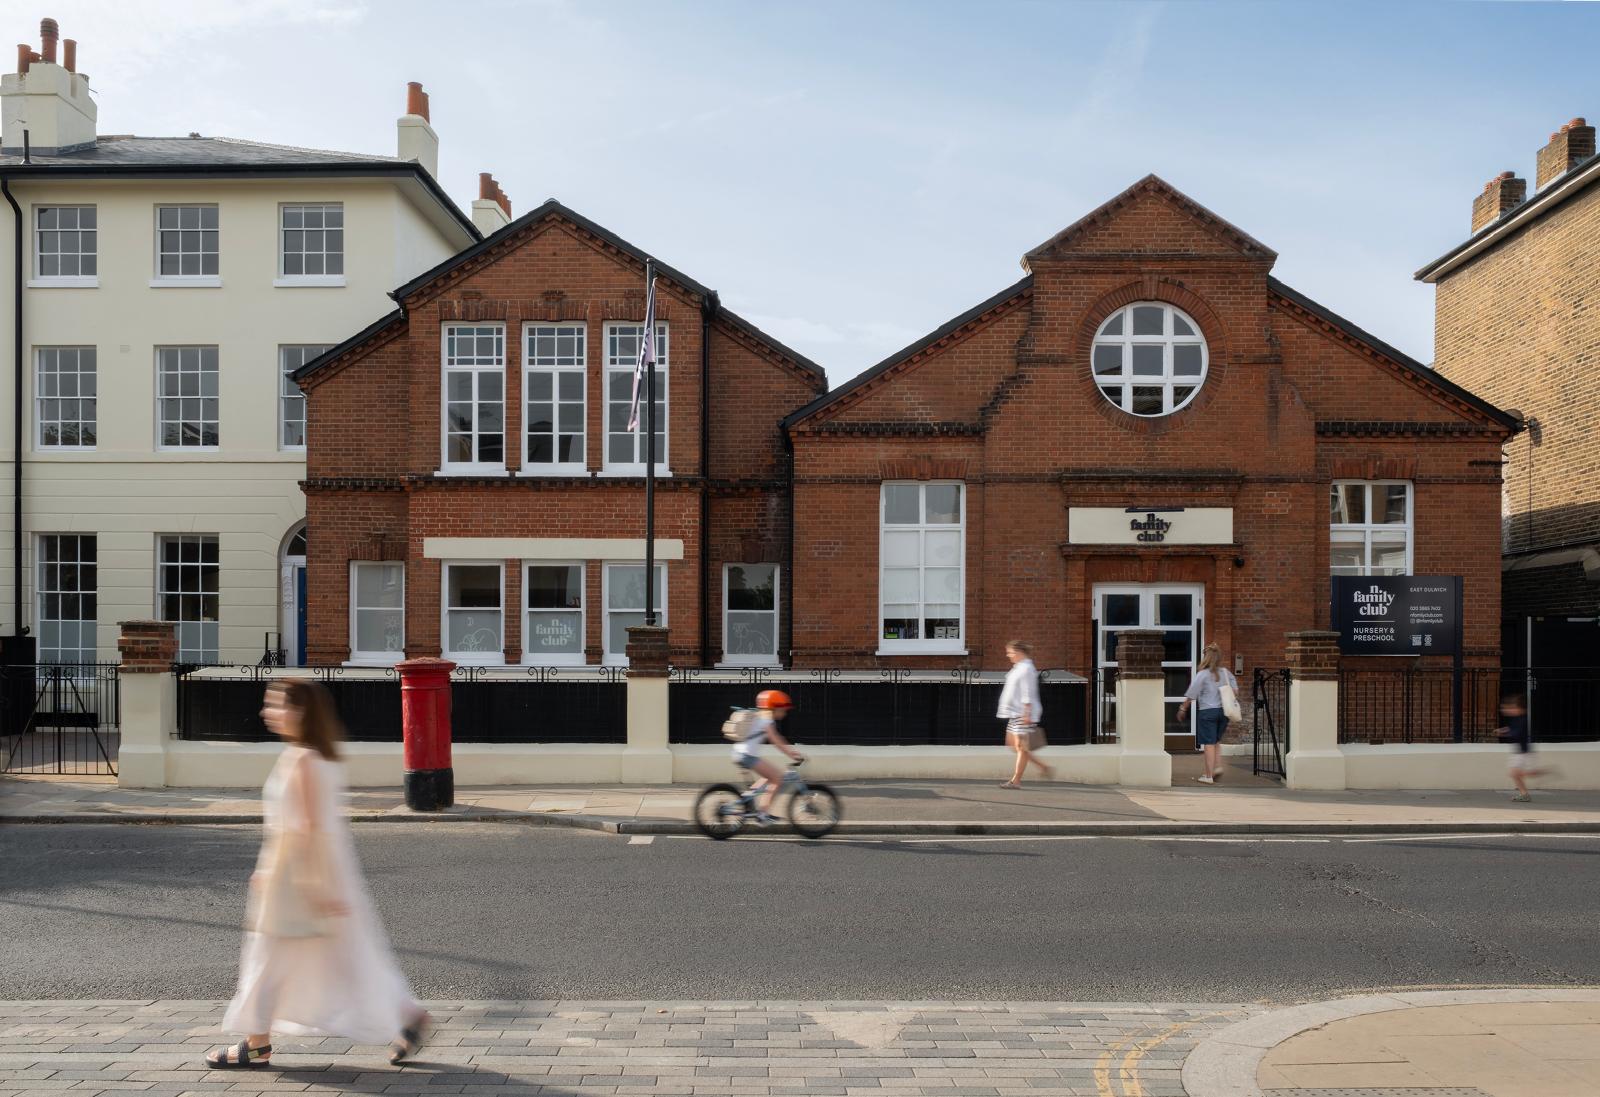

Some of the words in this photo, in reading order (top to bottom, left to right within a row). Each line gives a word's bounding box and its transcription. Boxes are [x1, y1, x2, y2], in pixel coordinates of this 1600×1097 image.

[1146, 513, 1155, 522] n
[1130, 518, 1171, 533] family
[1136, 531, 1165, 542] club
[1369, 585, 1379, 594] n
[1353, 589, 1395, 606] family
[1359, 603, 1388, 616] club
[535, 623, 573, 638] family
[541, 635, 568, 646] club
[1353, 634, 1395, 642] PRESCHOOL
